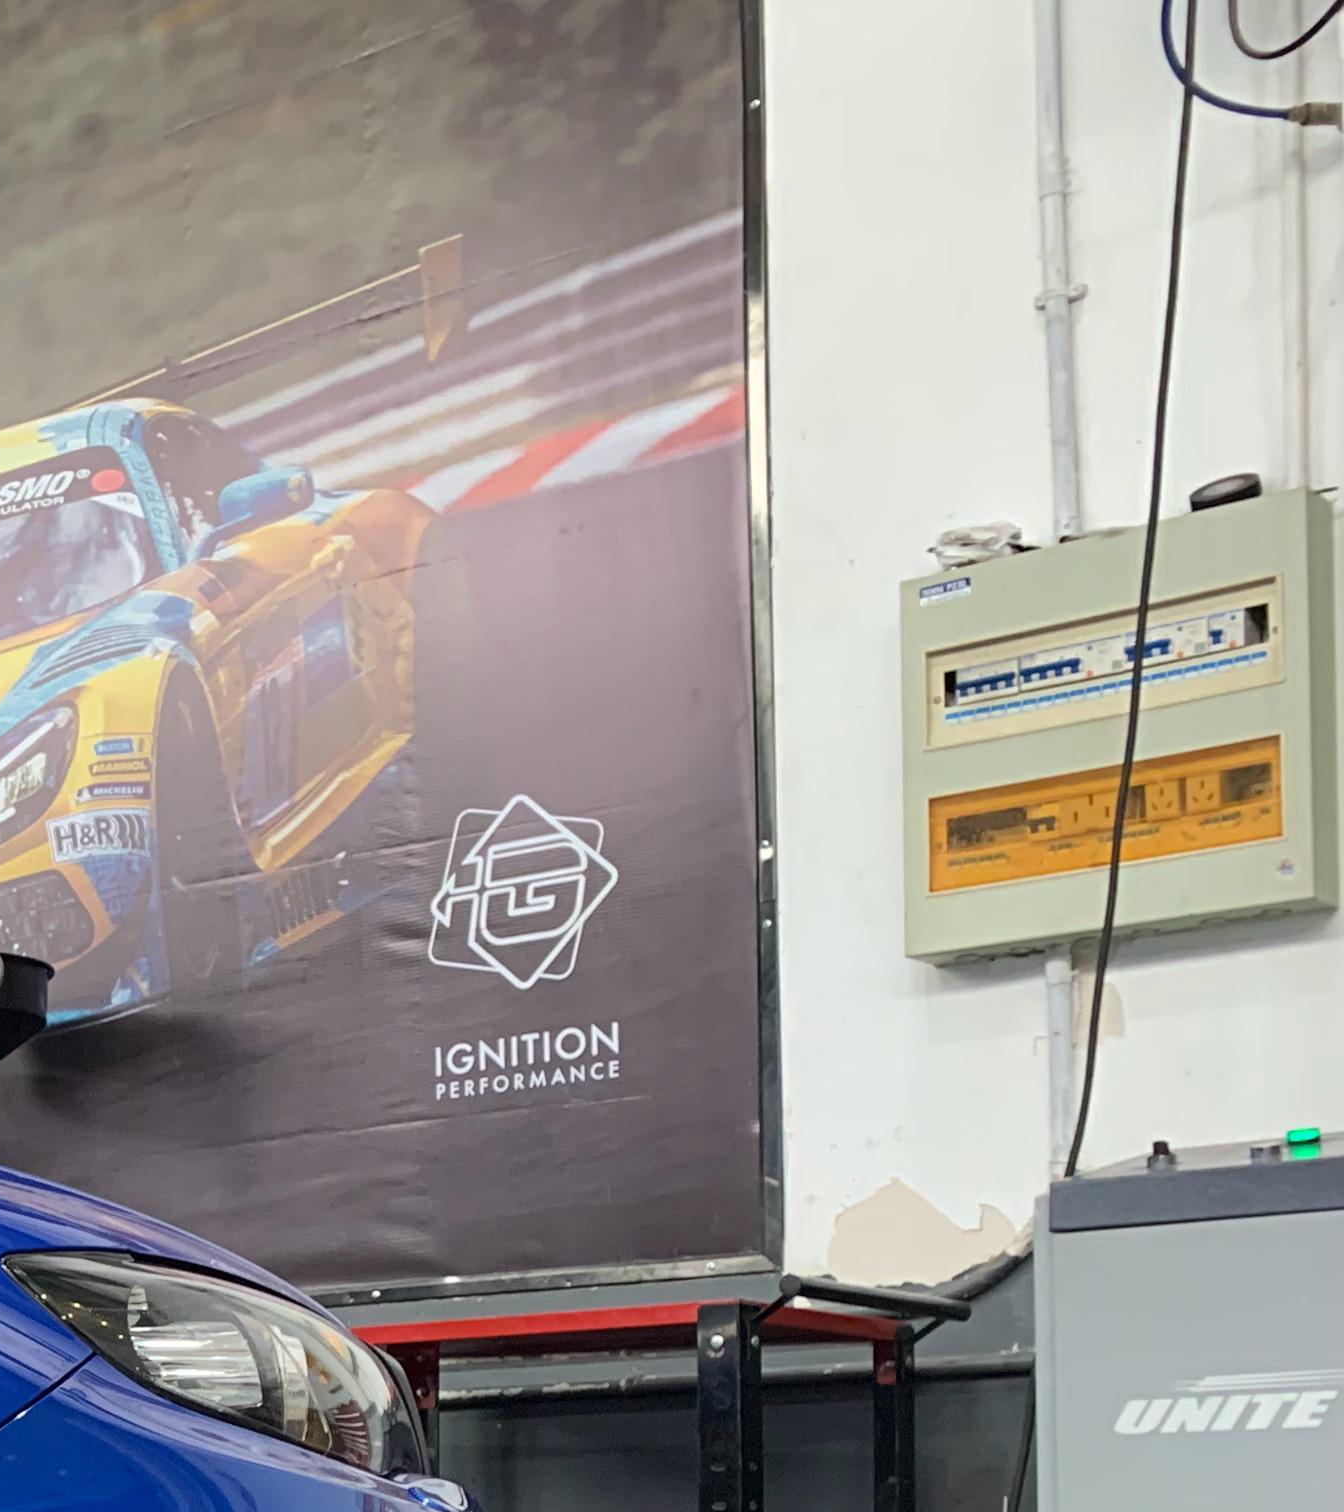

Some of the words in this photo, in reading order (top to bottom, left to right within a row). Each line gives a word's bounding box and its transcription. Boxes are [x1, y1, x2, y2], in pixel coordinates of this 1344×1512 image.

[93, 785, 145, 796] MICHELIN
[54, 815, 114, 853] H&R
[434, 1021, 620, 1077] IGNITION
[435, 1060, 621, 1101] PERFORMANCE
[1113, 1390, 1339, 1435] UNITE
